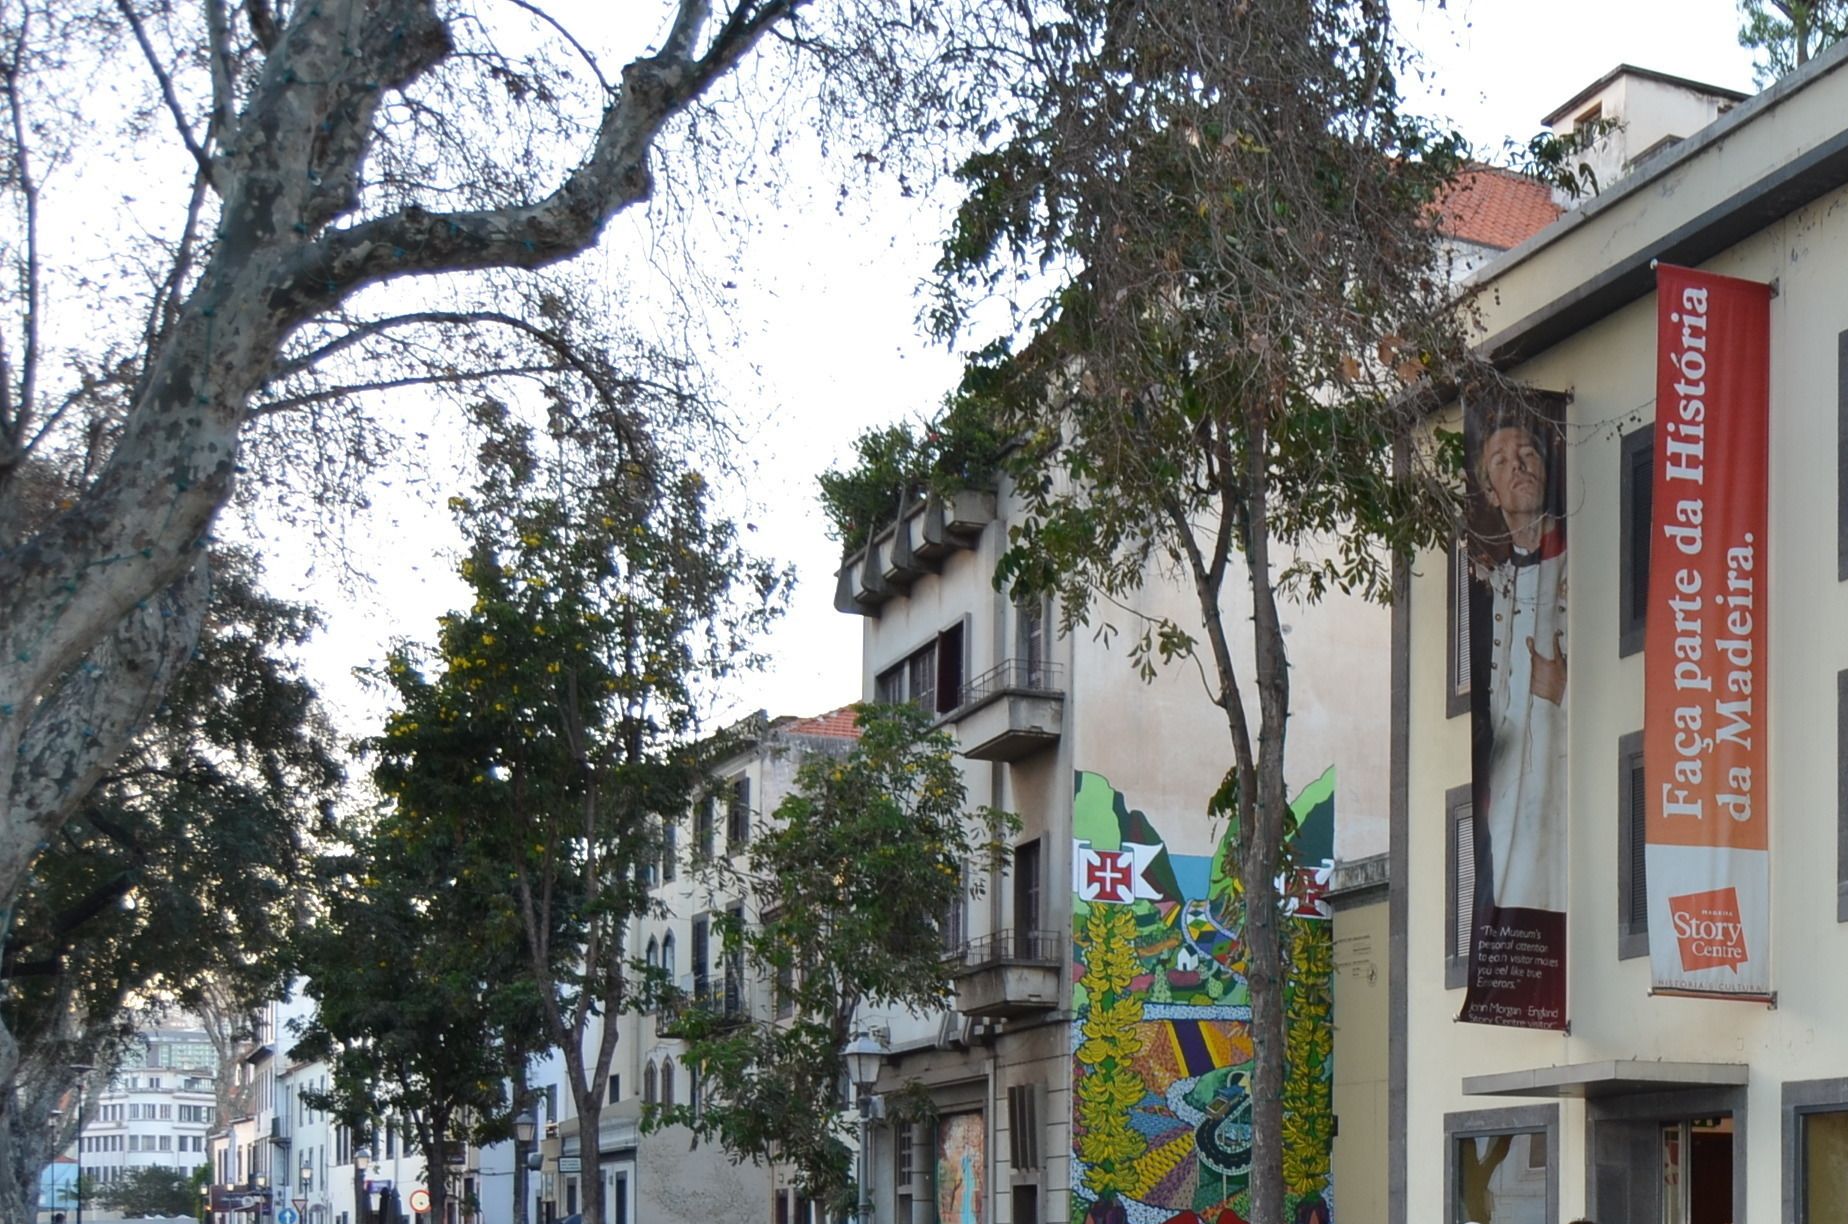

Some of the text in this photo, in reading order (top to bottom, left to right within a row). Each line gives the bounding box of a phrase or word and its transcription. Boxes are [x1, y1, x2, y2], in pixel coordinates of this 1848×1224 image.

[1662, 288, 1713, 820] Faça parte da História
[1715, 533, 1754, 822] da Madeira.
[1674, 911, 1742, 946] Story
[1692, 941, 1742, 958] Centre
